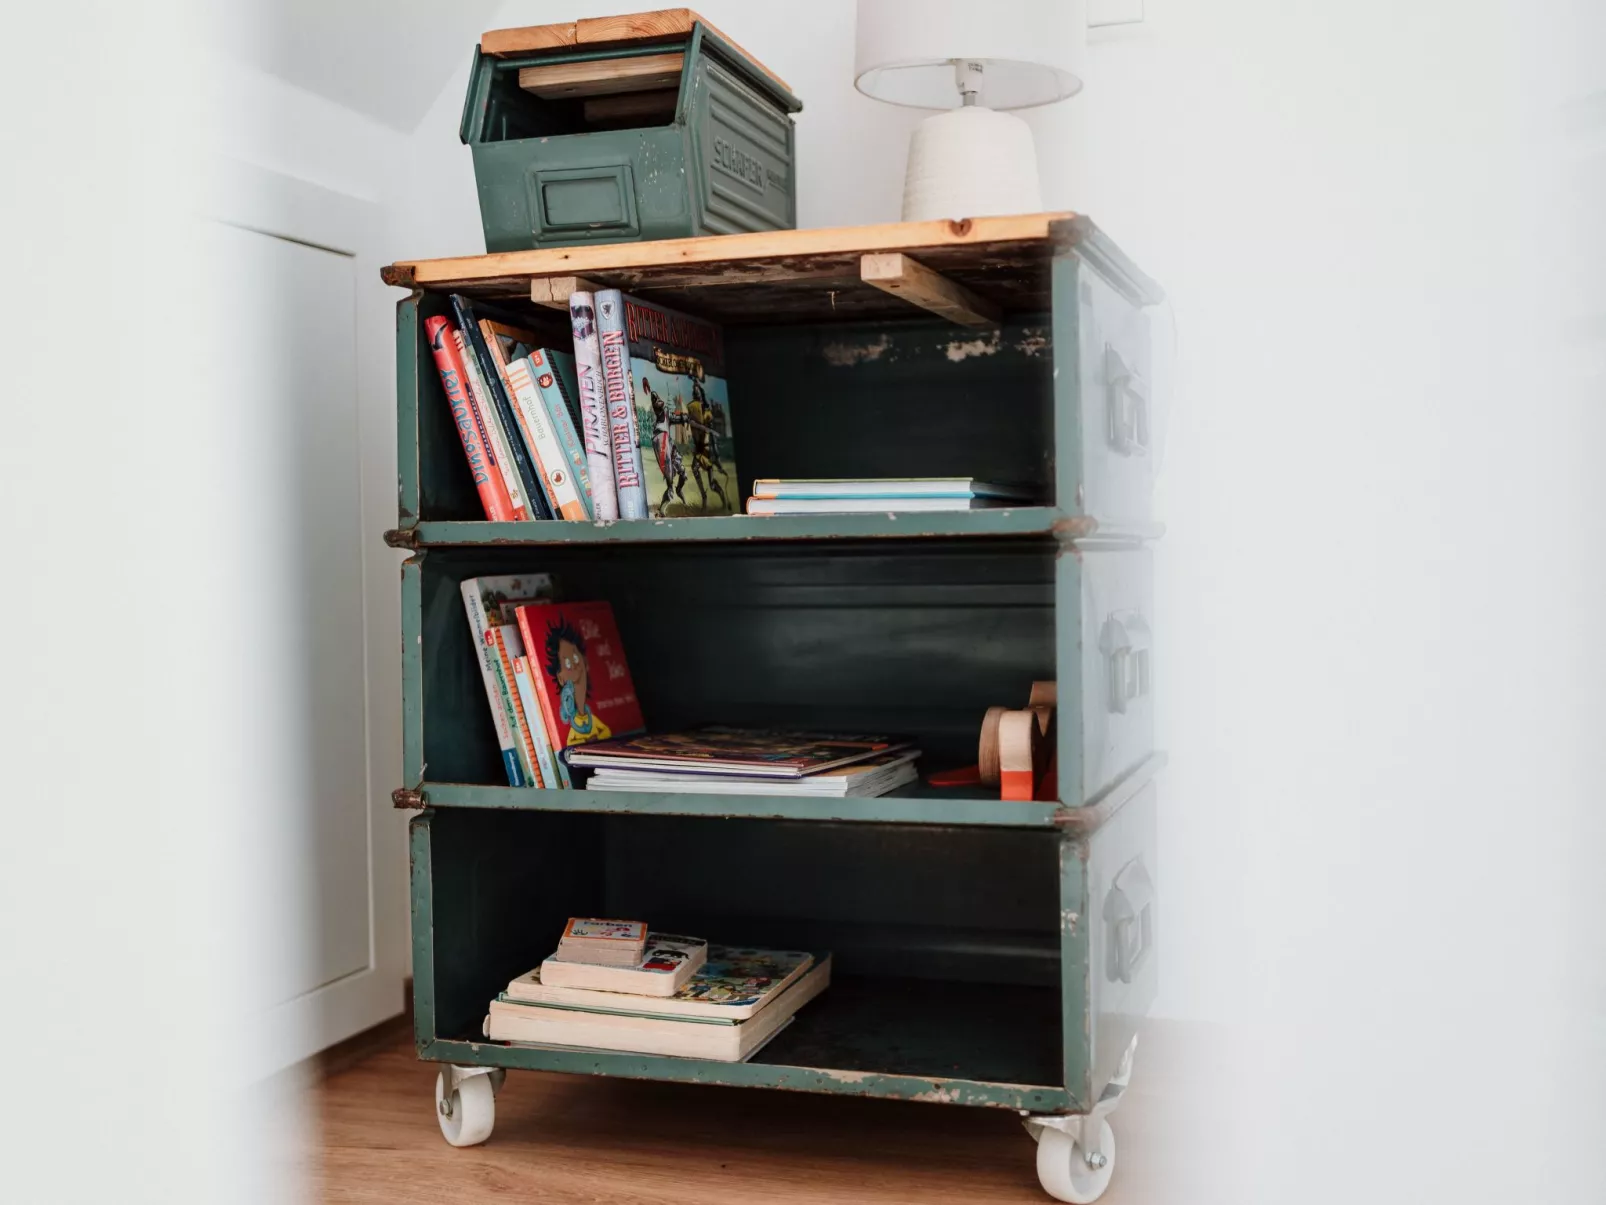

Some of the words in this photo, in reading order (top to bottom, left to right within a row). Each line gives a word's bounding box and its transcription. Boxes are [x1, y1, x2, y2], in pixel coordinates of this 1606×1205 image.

[602, 329, 626, 403] BURGEN
[440, 368, 489, 487] Dinosaurier
[521, 396, 546, 441] Bauernhof
[578, 362, 608, 457] PIRATEN
[595, 370, 609, 447] SCHABLONENBUCH
[611, 406, 627, 420] &
[612, 422, 640, 489] RITTER
[469, 595, 485, 645] Wimmelbilder
[482, 647, 493, 672] Meine
[494, 659, 509, 696] Bauernhof
[506, 697, 514, 713] dem
[510, 716, 519, 729] Auf
